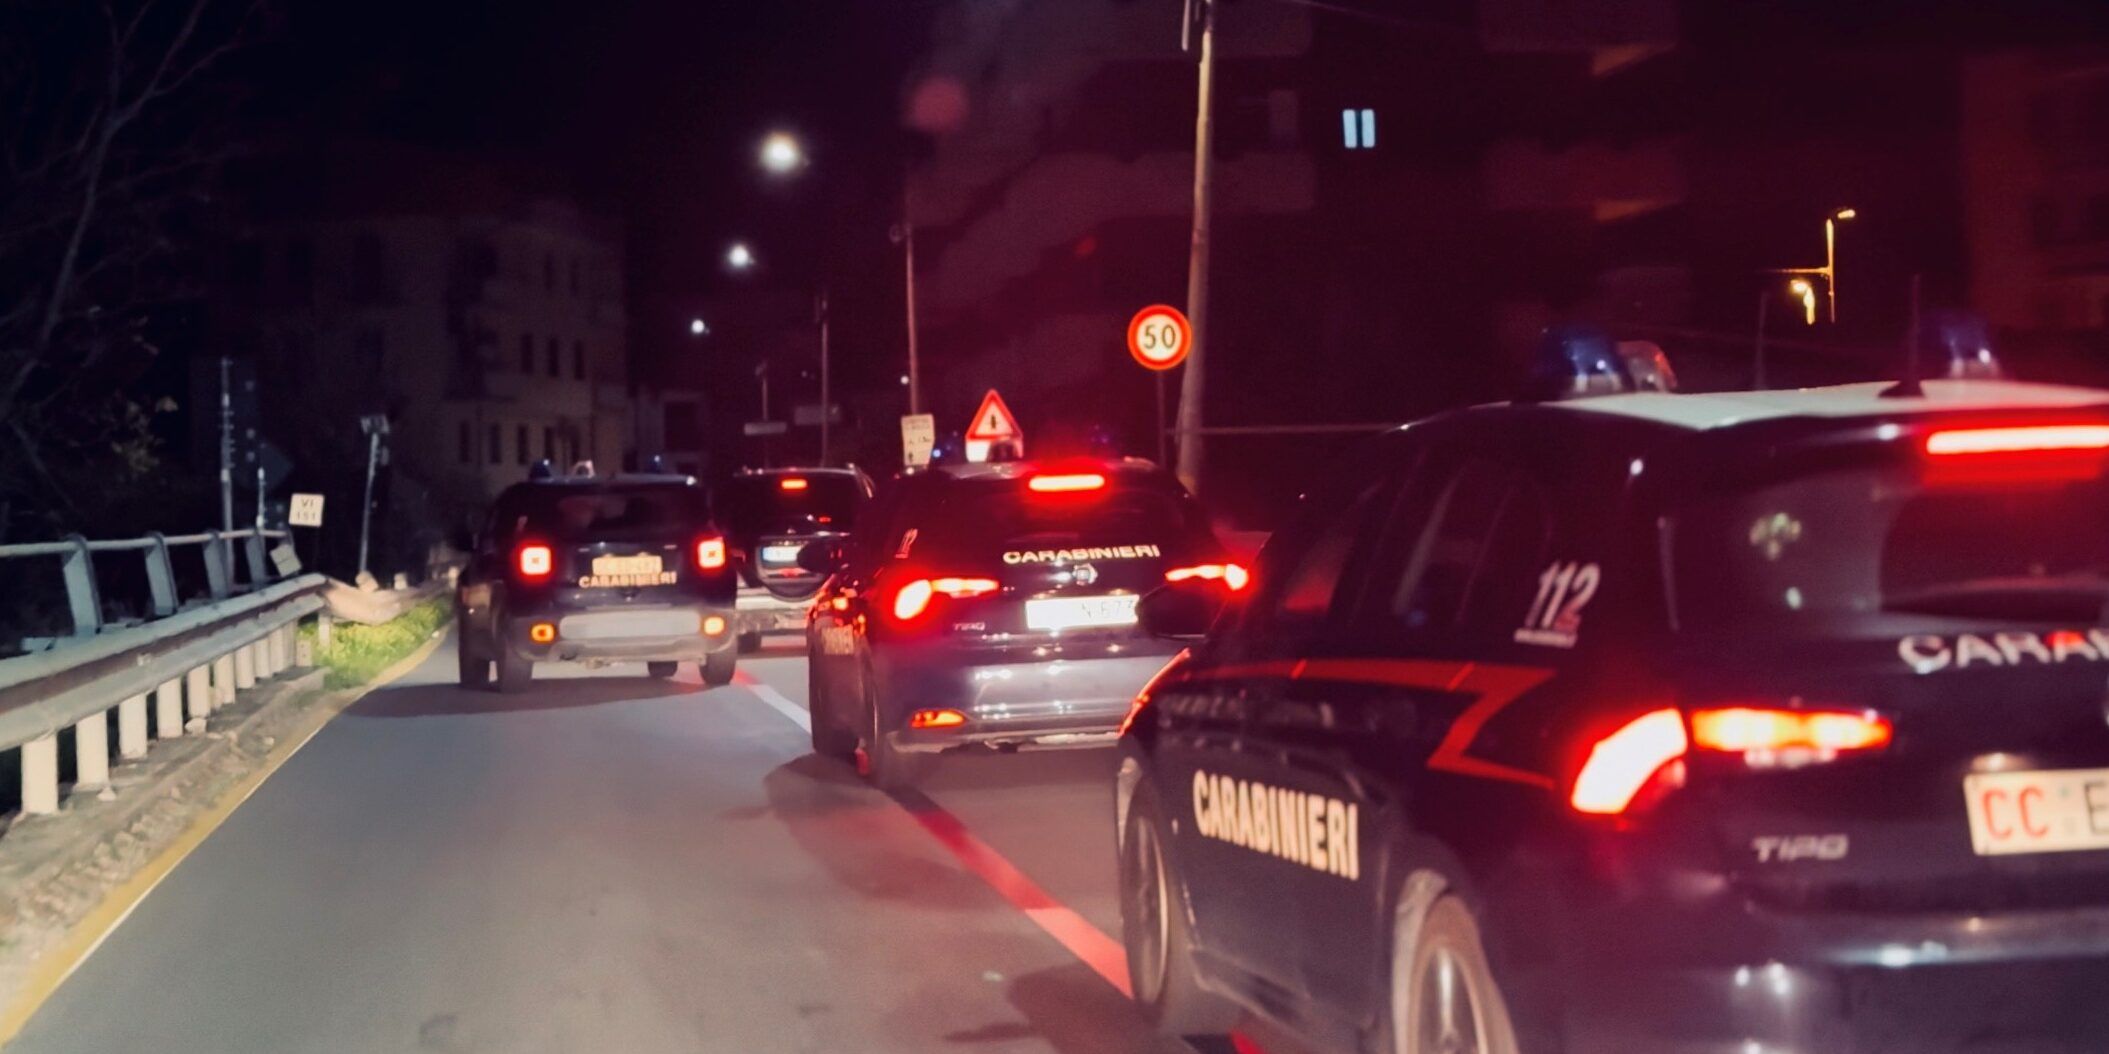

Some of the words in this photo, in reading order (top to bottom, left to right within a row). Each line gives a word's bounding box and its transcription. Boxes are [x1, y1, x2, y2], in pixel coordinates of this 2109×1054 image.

[1144, 323, 1176, 350] 50
[1002, 545, 1161, 565] CARABINIERI
[1524, 560, 1601, 631] 112
[1192, 768, 1360, 881] CARABINIERI
[1981, 785, 2050, 839] CC
[1752, 833, 1850, 863] TIPO
